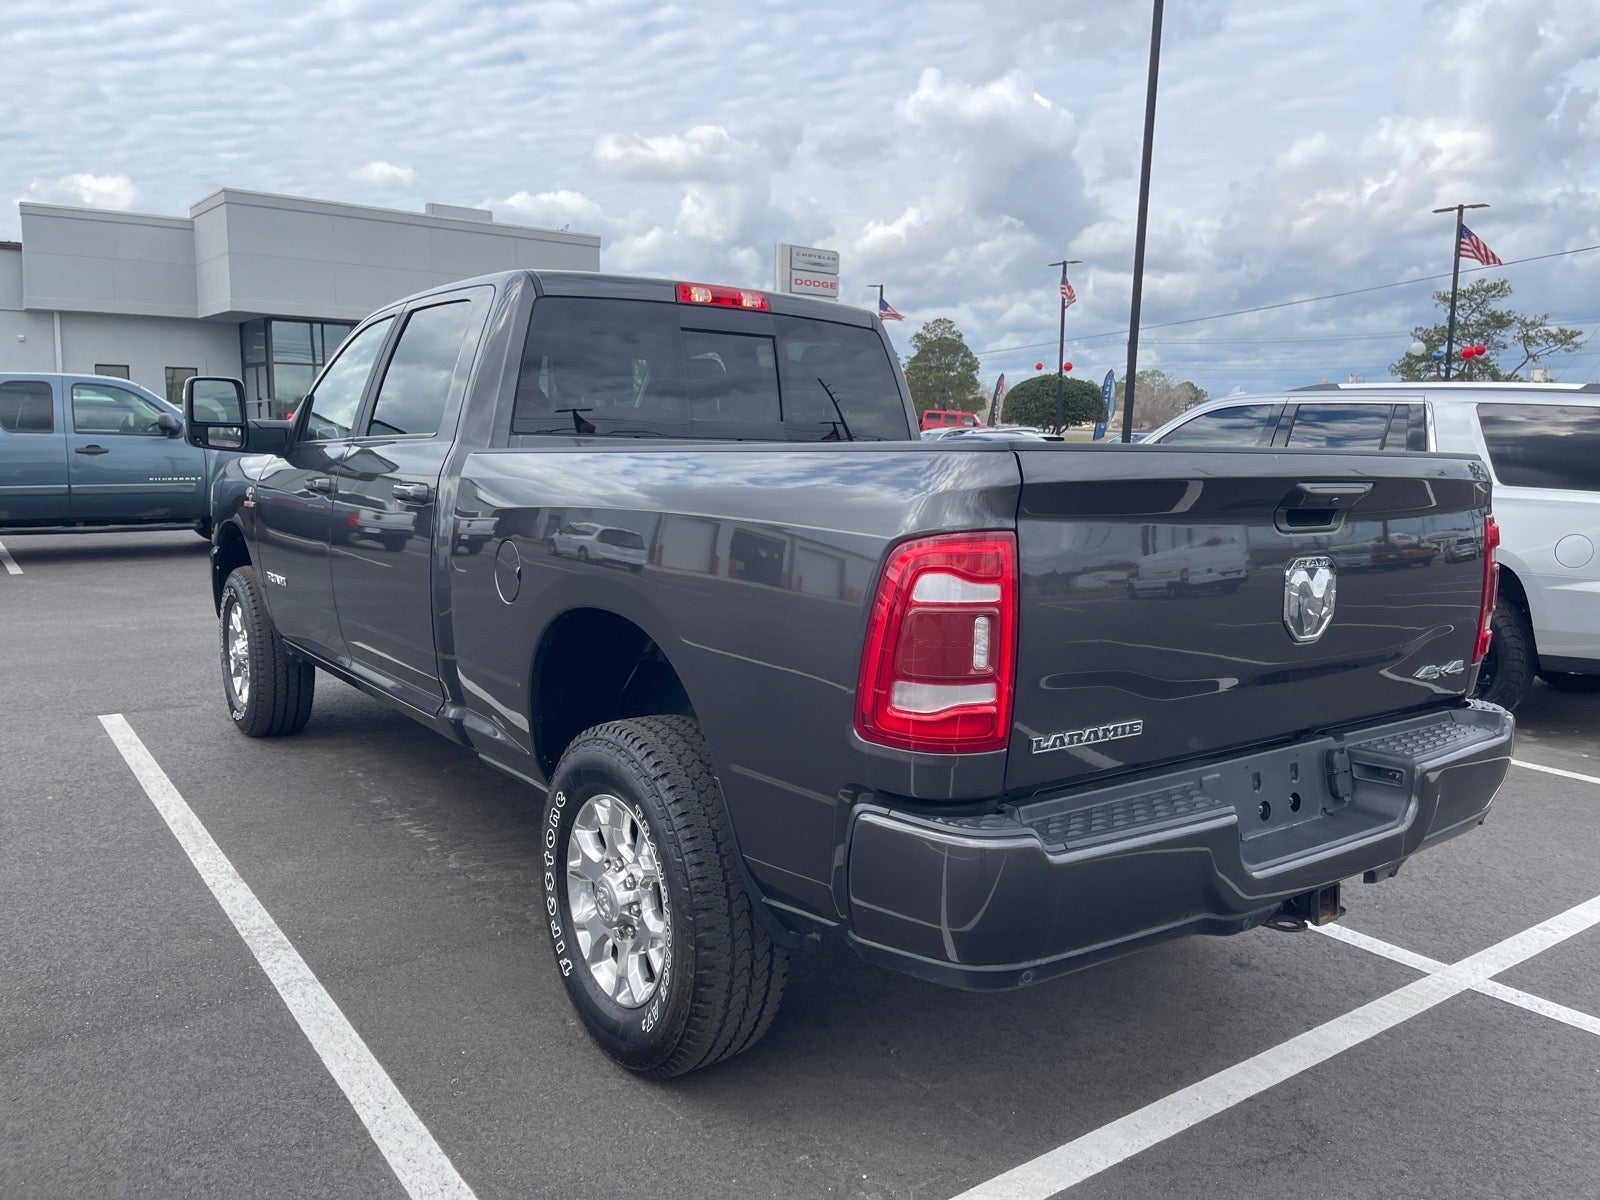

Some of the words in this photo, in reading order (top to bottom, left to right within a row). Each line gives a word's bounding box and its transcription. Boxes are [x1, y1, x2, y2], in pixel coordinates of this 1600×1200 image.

[795, 252, 836, 261] CHRYSLER
[794, 278, 837, 290] DODGE
[1299, 559, 1330, 567] RAM
[1030, 720, 1143, 754] LARAMIE
